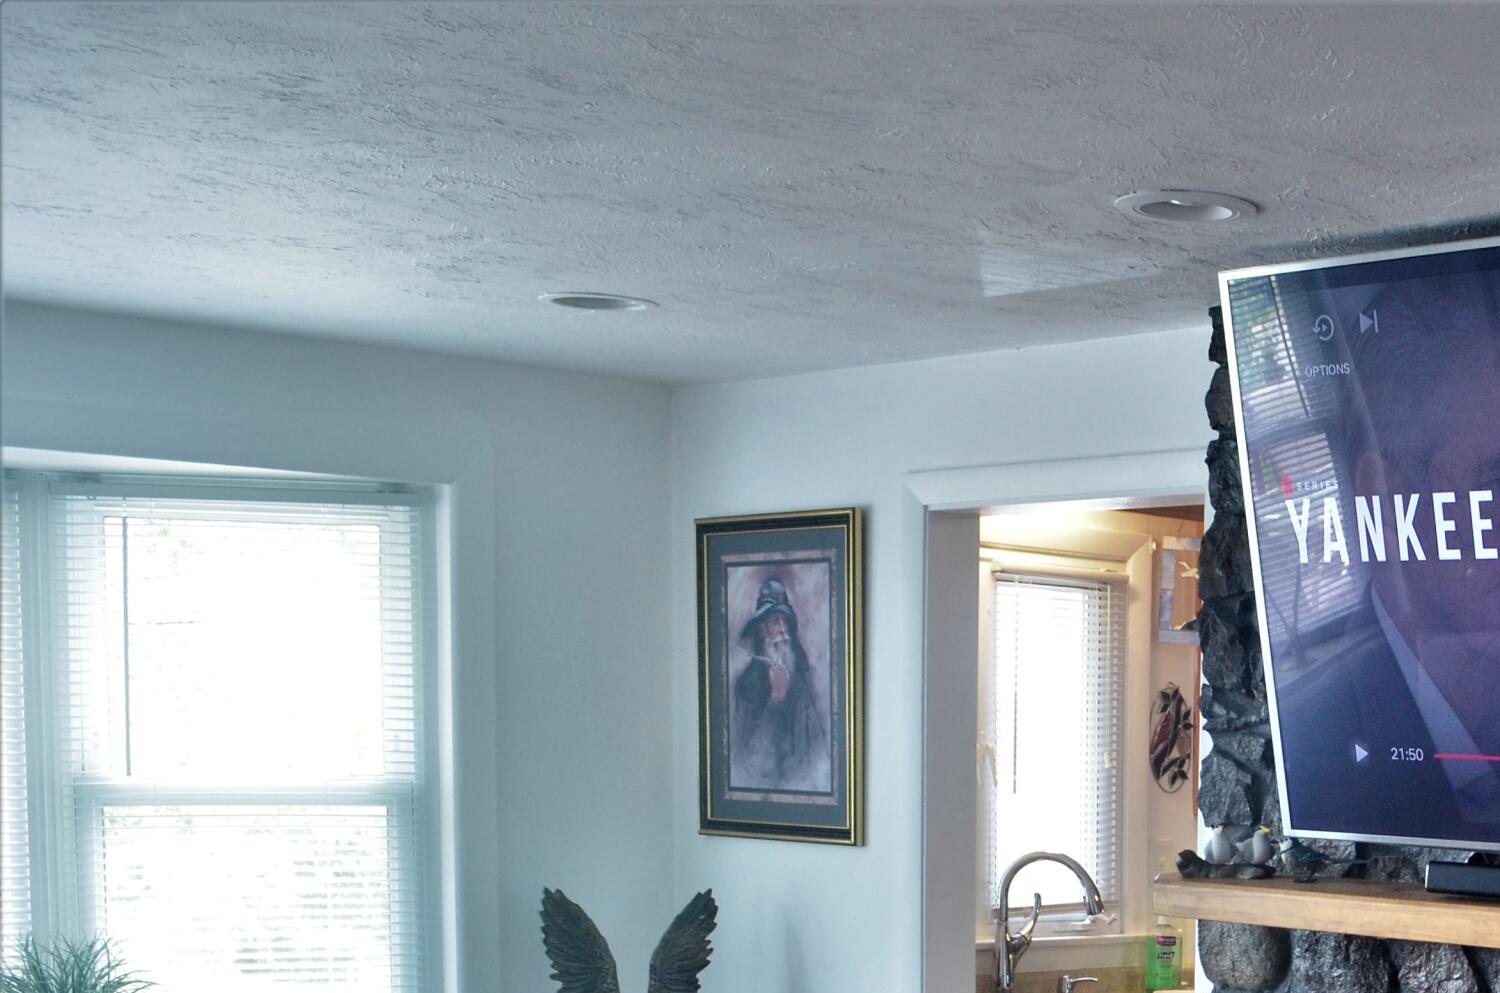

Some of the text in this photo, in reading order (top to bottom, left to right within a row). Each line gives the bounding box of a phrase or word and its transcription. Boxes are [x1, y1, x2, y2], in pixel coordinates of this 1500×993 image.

[1304, 362, 1351, 378] OPTIONS
[1296, 479, 1339, 491] SERIES
[1285, 489, 1499, 564] YANKEE
[1390, 747, 1424, 762] 21:50
